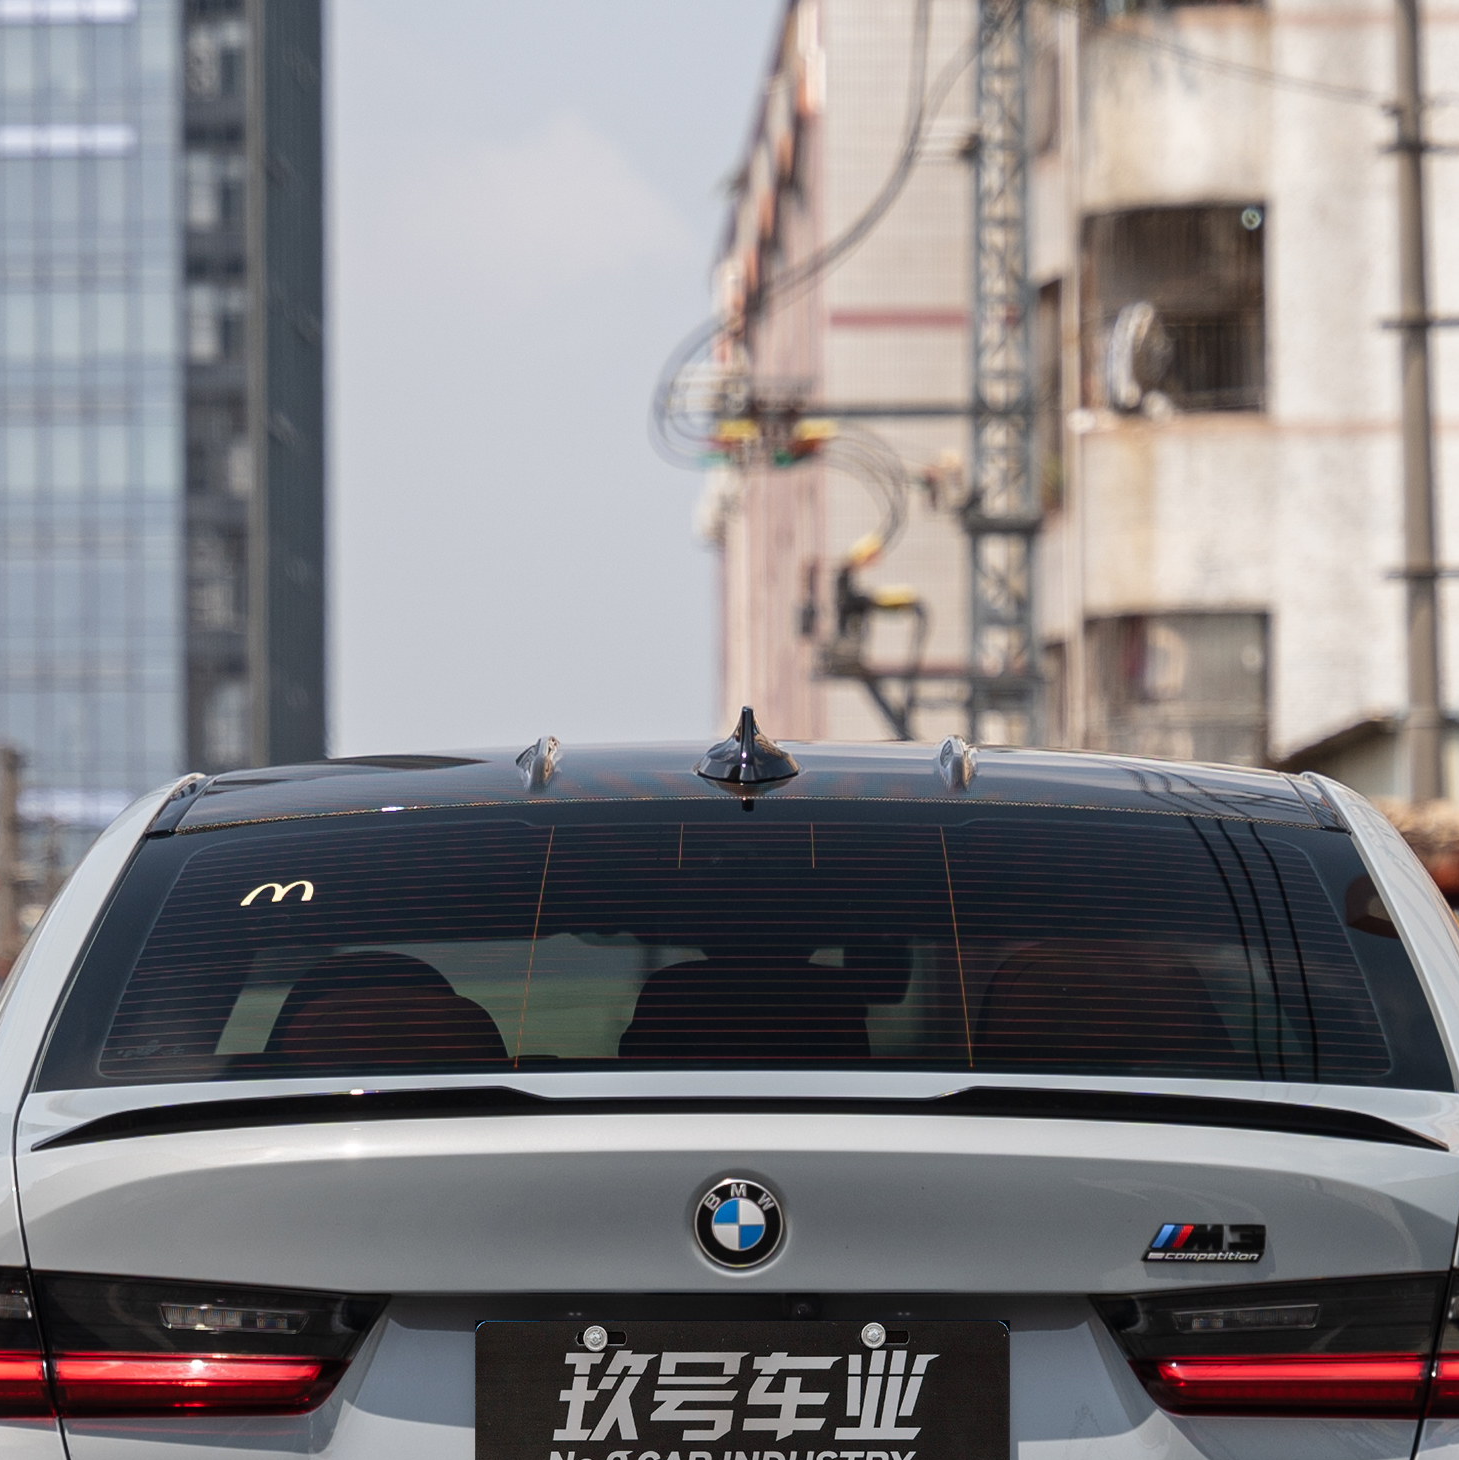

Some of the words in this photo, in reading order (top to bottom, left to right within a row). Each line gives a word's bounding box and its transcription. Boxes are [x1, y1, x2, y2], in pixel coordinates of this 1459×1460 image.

[703, 1183, 775, 1212] BMW
[1164, 1251, 1260, 1262] competition
[552, 1350, 940, 1442] 玖号车业
